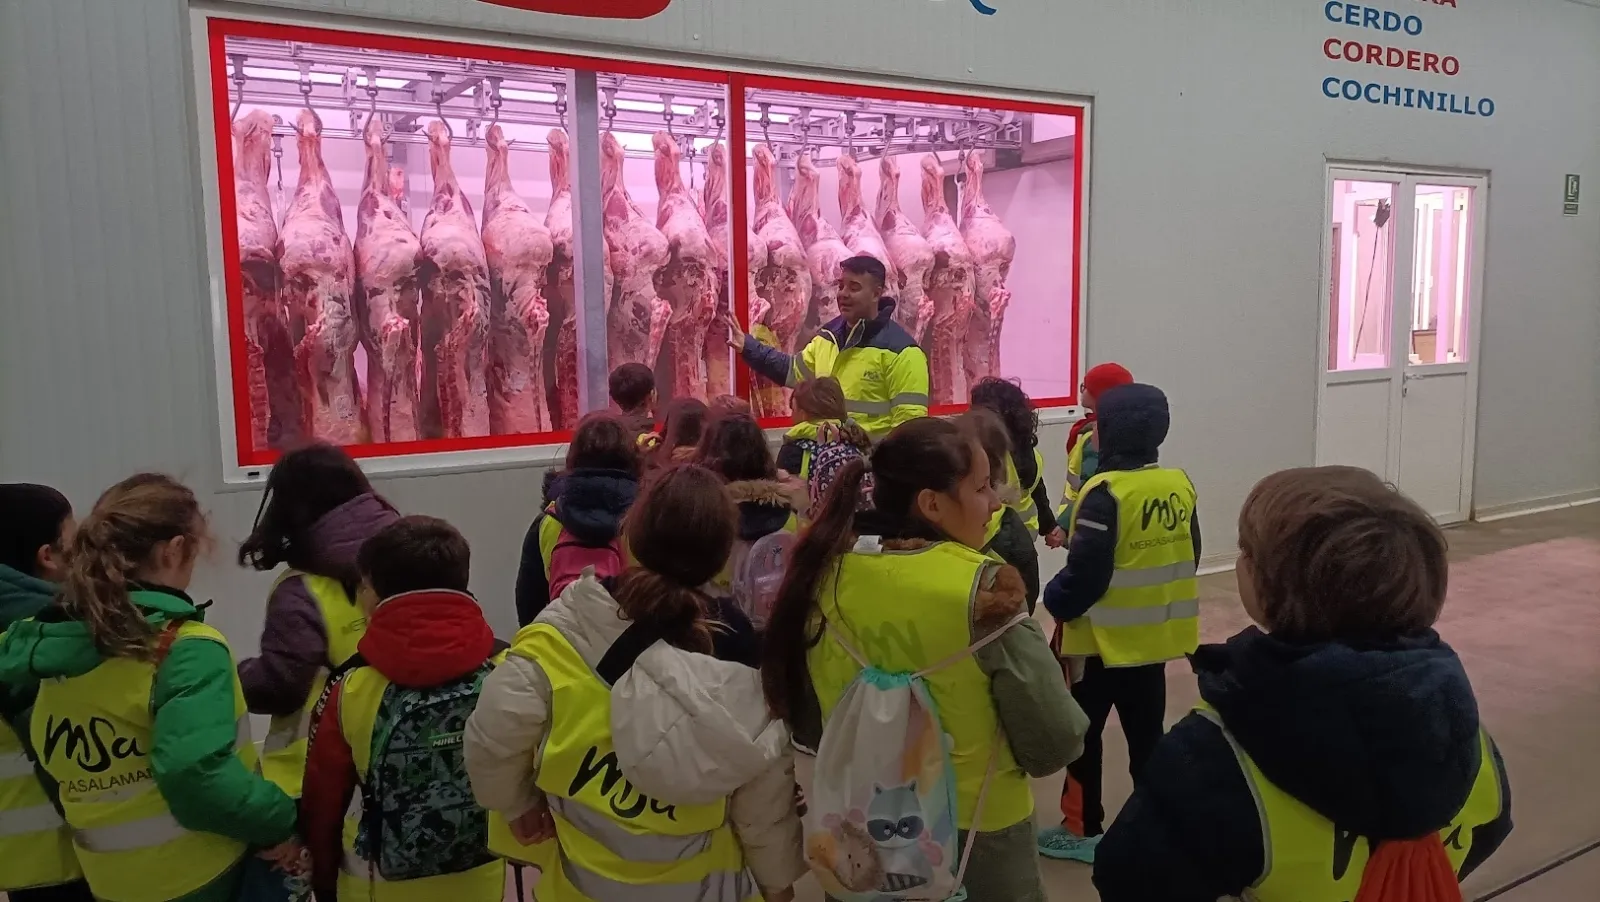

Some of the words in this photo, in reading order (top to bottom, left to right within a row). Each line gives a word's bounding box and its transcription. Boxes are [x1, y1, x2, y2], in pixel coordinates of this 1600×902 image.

[1324, 0, 1423, 36] CERDO
[1322, 38, 1460, 76] CORDERO
[1321, 76, 1495, 117] COCHINILLO
